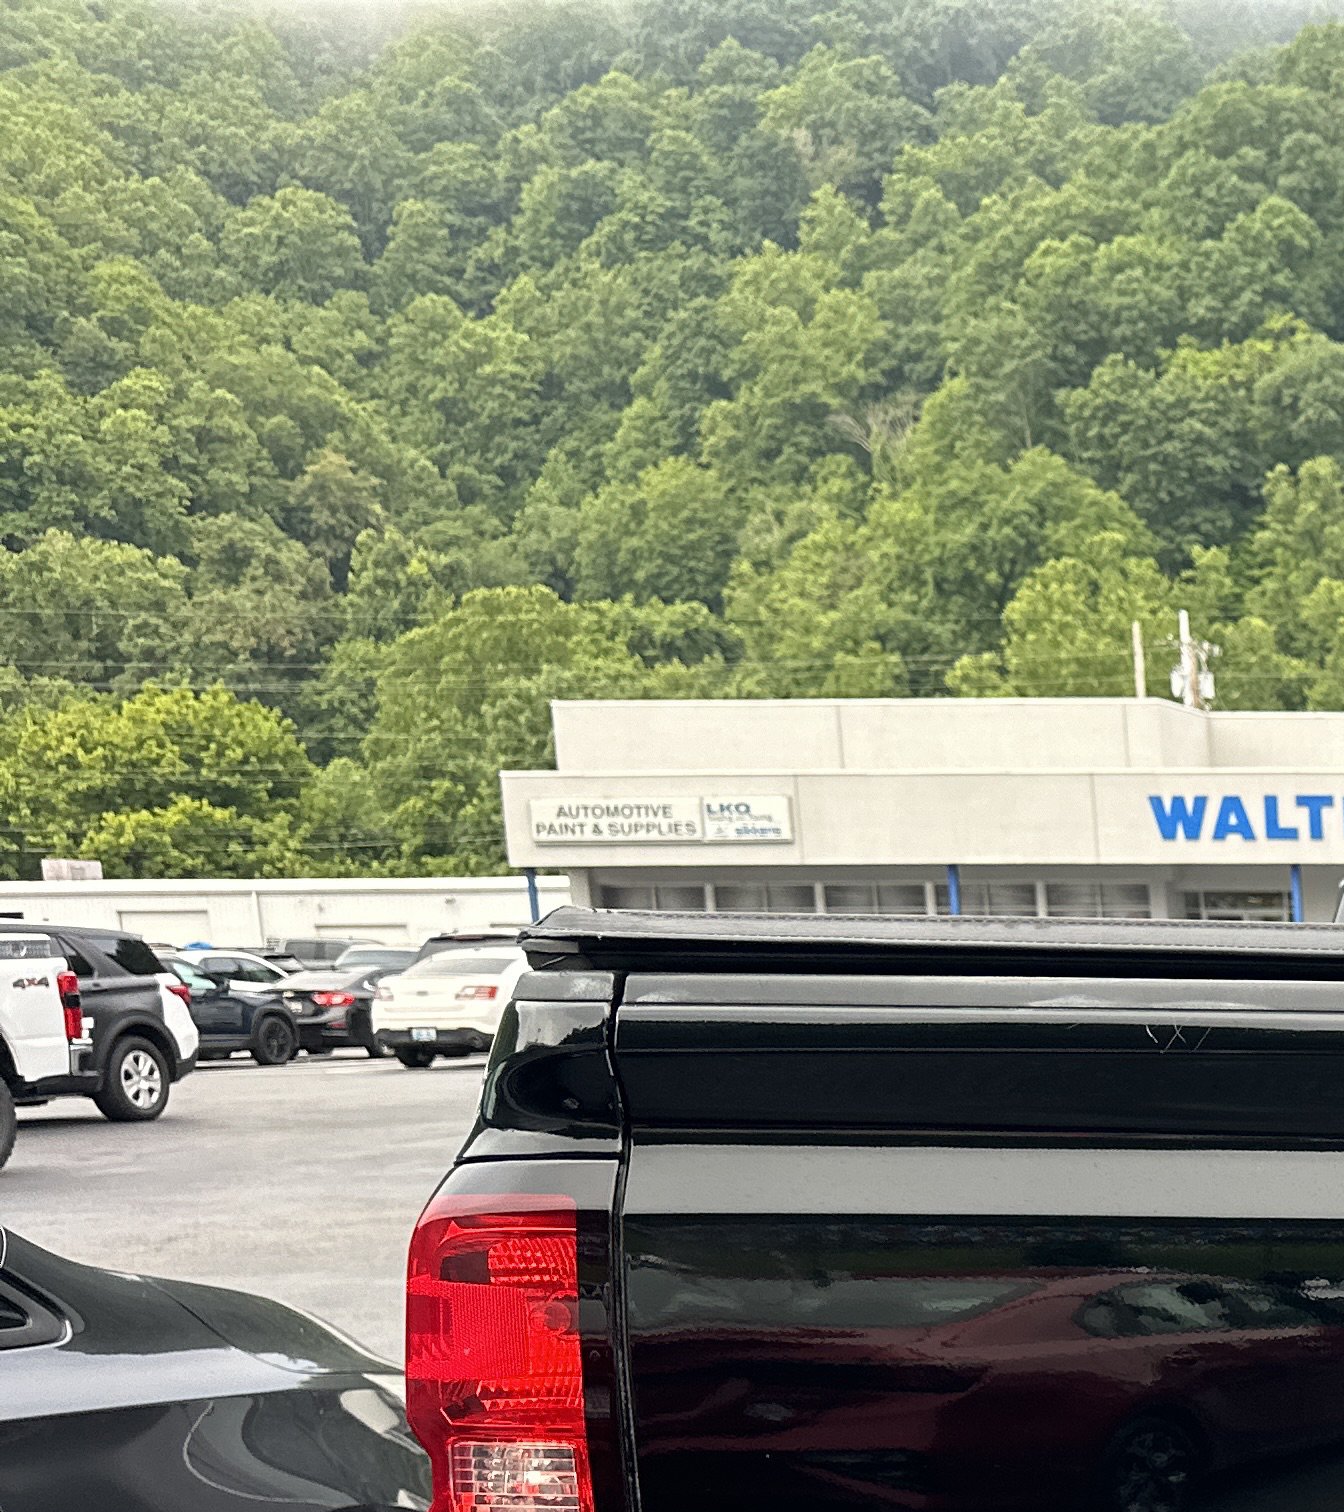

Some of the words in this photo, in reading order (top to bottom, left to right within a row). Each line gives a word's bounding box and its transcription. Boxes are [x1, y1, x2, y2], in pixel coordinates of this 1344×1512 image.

[556, 803, 674, 819] AUTOMOTIVE
[535, 821, 586, 836] PAINT
[607, 820, 697, 836] SUPPLIES
